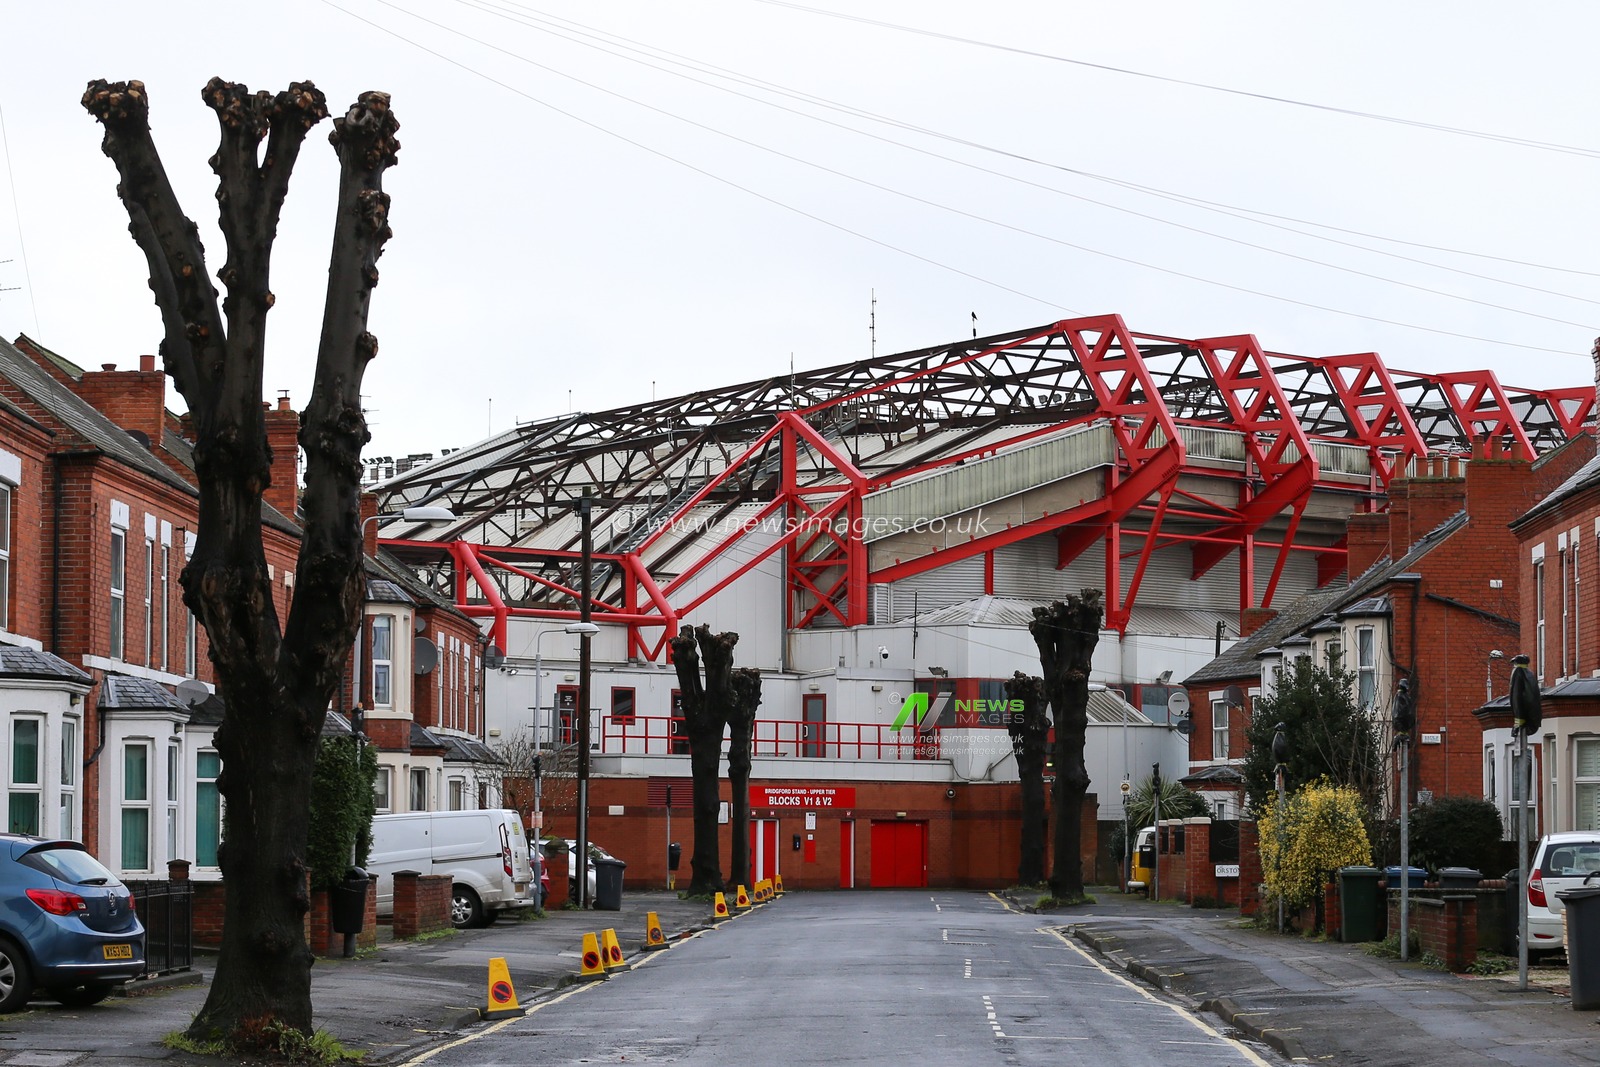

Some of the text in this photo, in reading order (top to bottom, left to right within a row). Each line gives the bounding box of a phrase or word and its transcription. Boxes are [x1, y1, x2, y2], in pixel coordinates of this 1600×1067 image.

[768, 796, 832, 806] BLOCKS V1 & V2
